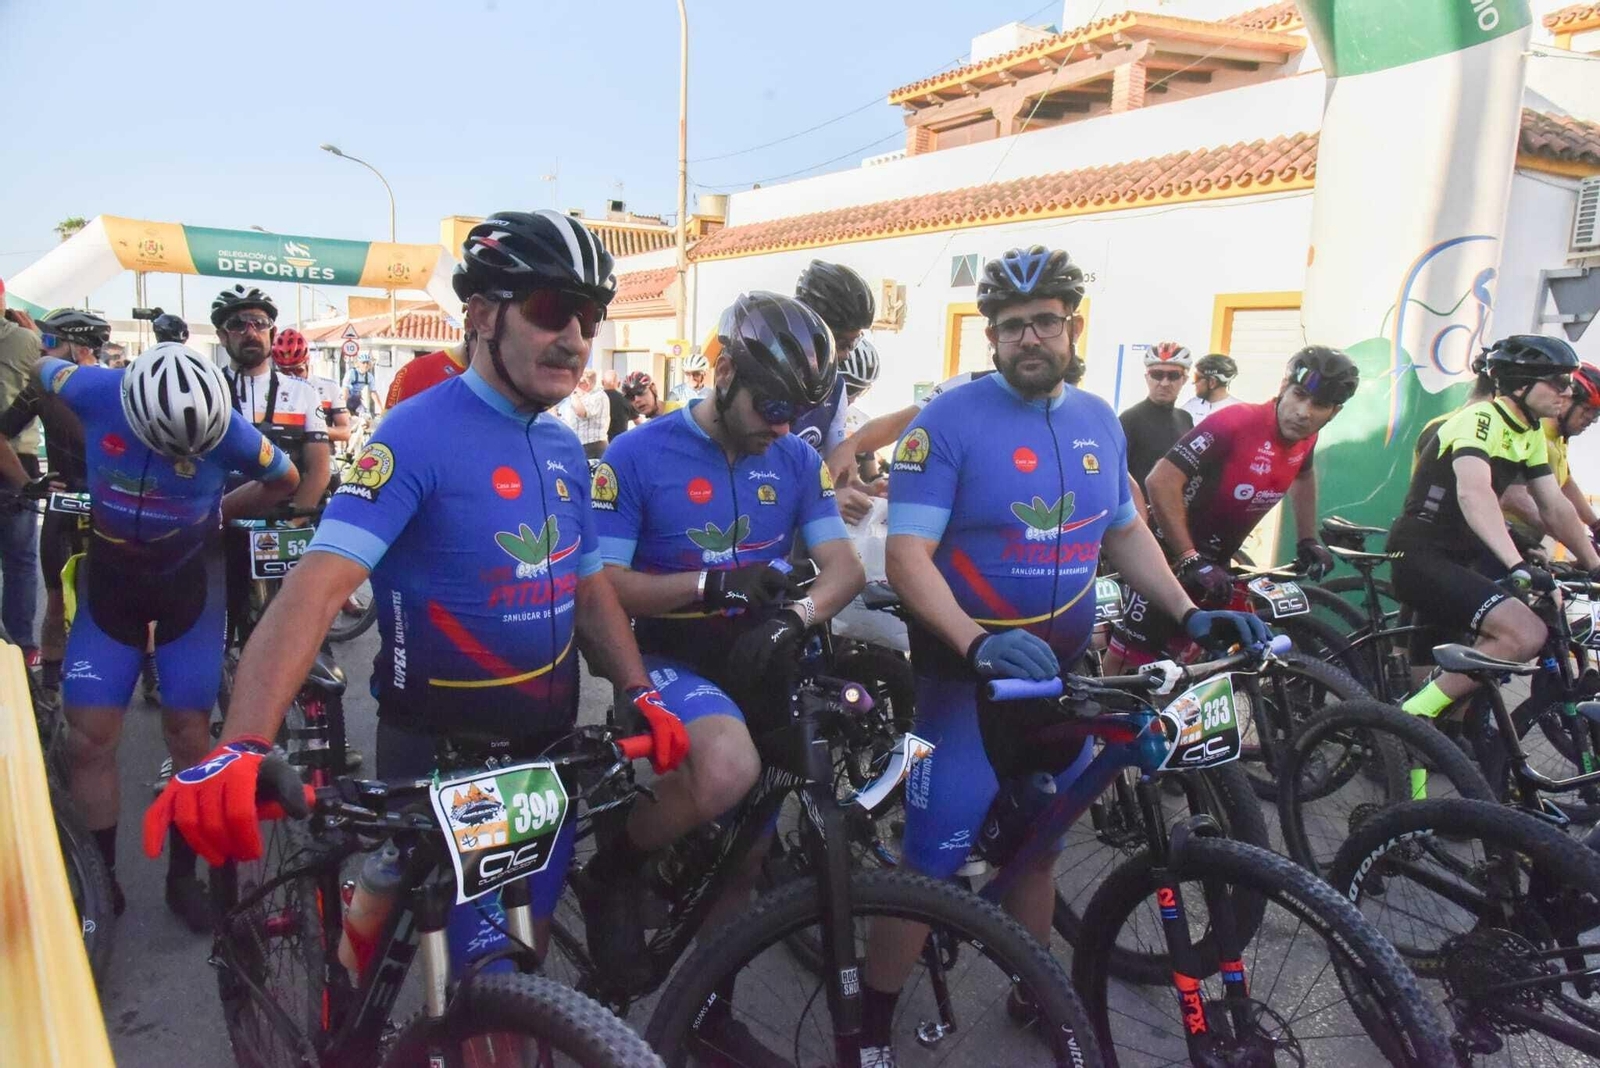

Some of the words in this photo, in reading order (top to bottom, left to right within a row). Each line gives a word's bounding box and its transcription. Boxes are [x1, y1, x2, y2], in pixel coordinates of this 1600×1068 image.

[218, 249, 267, 261] DELEGACIÓN
[268, 254, 278, 262] de
[217, 257, 336, 281] DEPORTES
[61, 325, 95, 333] SCOTT
[346, 344, 356, 352] 10
[748, 470, 781, 481] Spiuk
[1010, 566, 1046, 576] SANLÚCAR
[1047, 568, 1056, 576] DE
[391, 588, 406, 645] SALTAMONTES
[502, 611, 541, 623] SANLÚCAR
[543, 609, 552, 618] DE
[393, 646, 408, 690] SUPER
[1203, 694, 1231, 731] 333
[511, 789, 561, 835] 394
[1348, 828, 1435, 902] REYNOLD
[707, 992, 717, 1007] DT
[692, 1006, 709, 1030] SWISS
